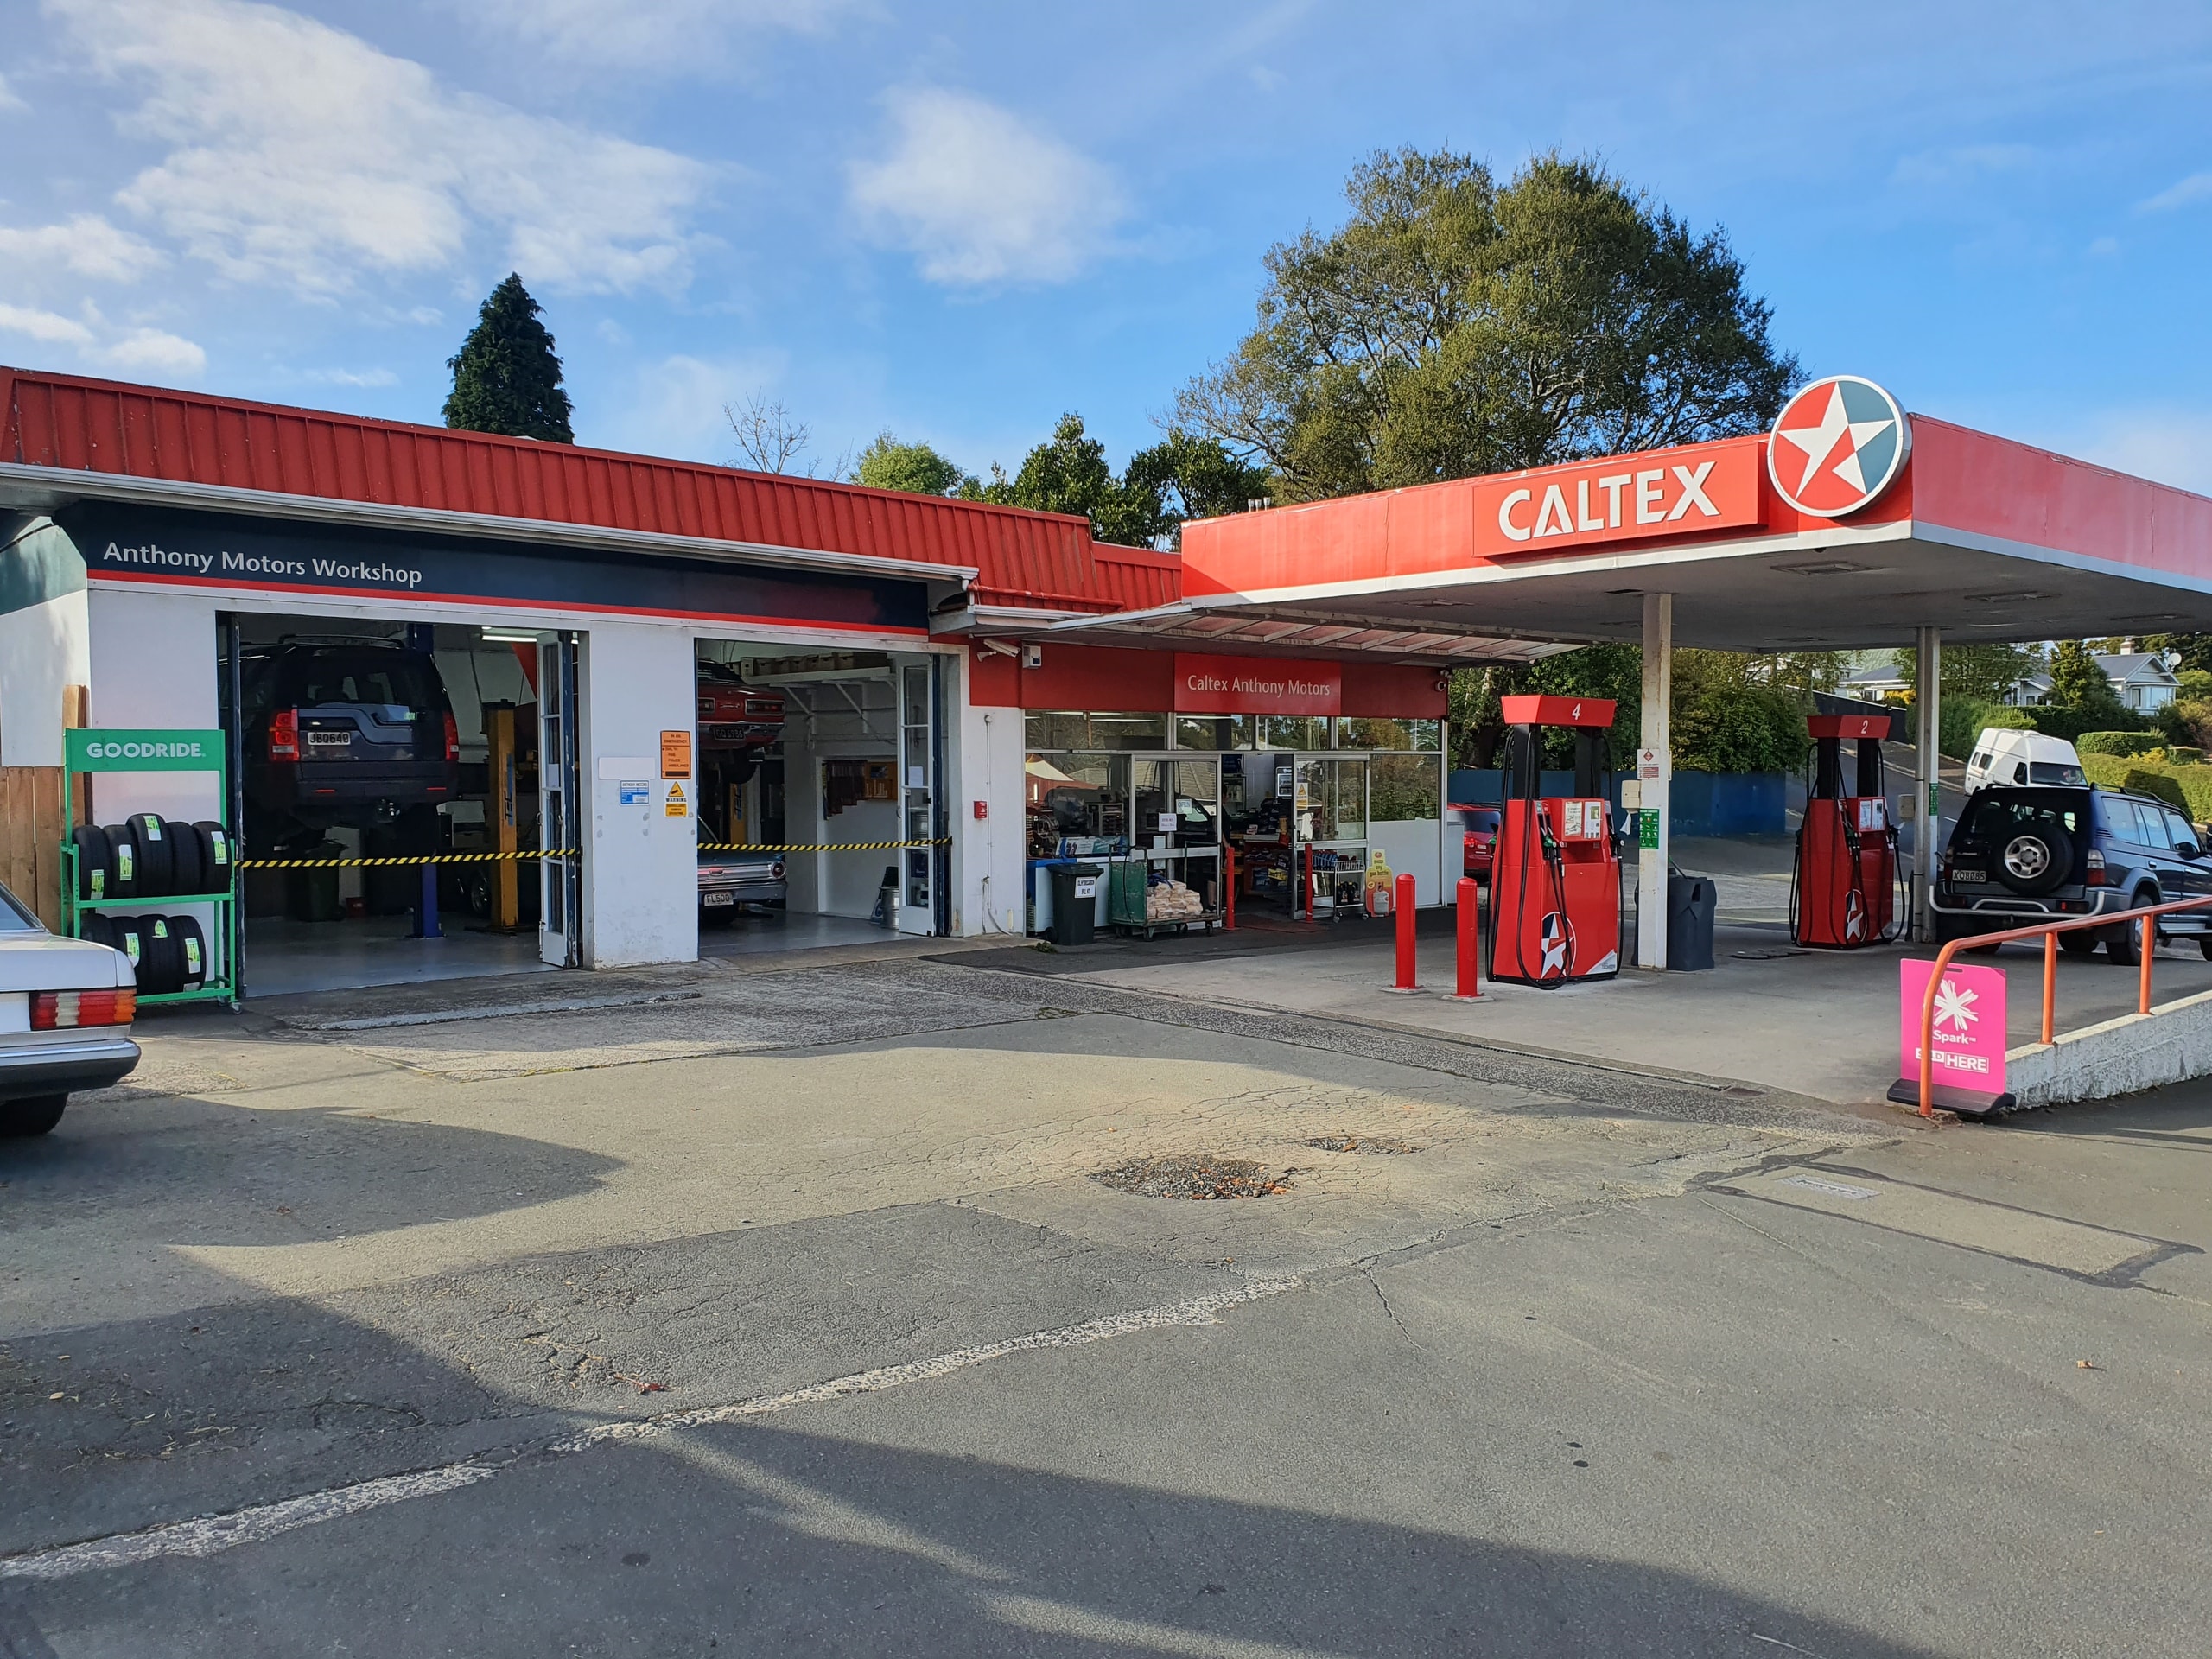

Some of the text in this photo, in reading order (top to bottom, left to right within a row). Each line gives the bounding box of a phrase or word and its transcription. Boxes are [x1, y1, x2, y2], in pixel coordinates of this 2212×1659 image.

[1498, 461, 1721, 541] CALTEX
[104, 542, 423, 588] Anthony Motors Workshop
[1187, 675, 1331, 698] Caltex Anthony Motors
[1571, 702, 1581, 721] 4
[1860, 719, 1869, 734] 2
[309, 734, 349, 743] JBQ640
[86, 742, 201, 759] GOODRIDE
[706, 893, 730, 903] FL500
[1932, 1029, 1969, 1045] Spark
[1946, 1054, 1986, 1071] HERE
